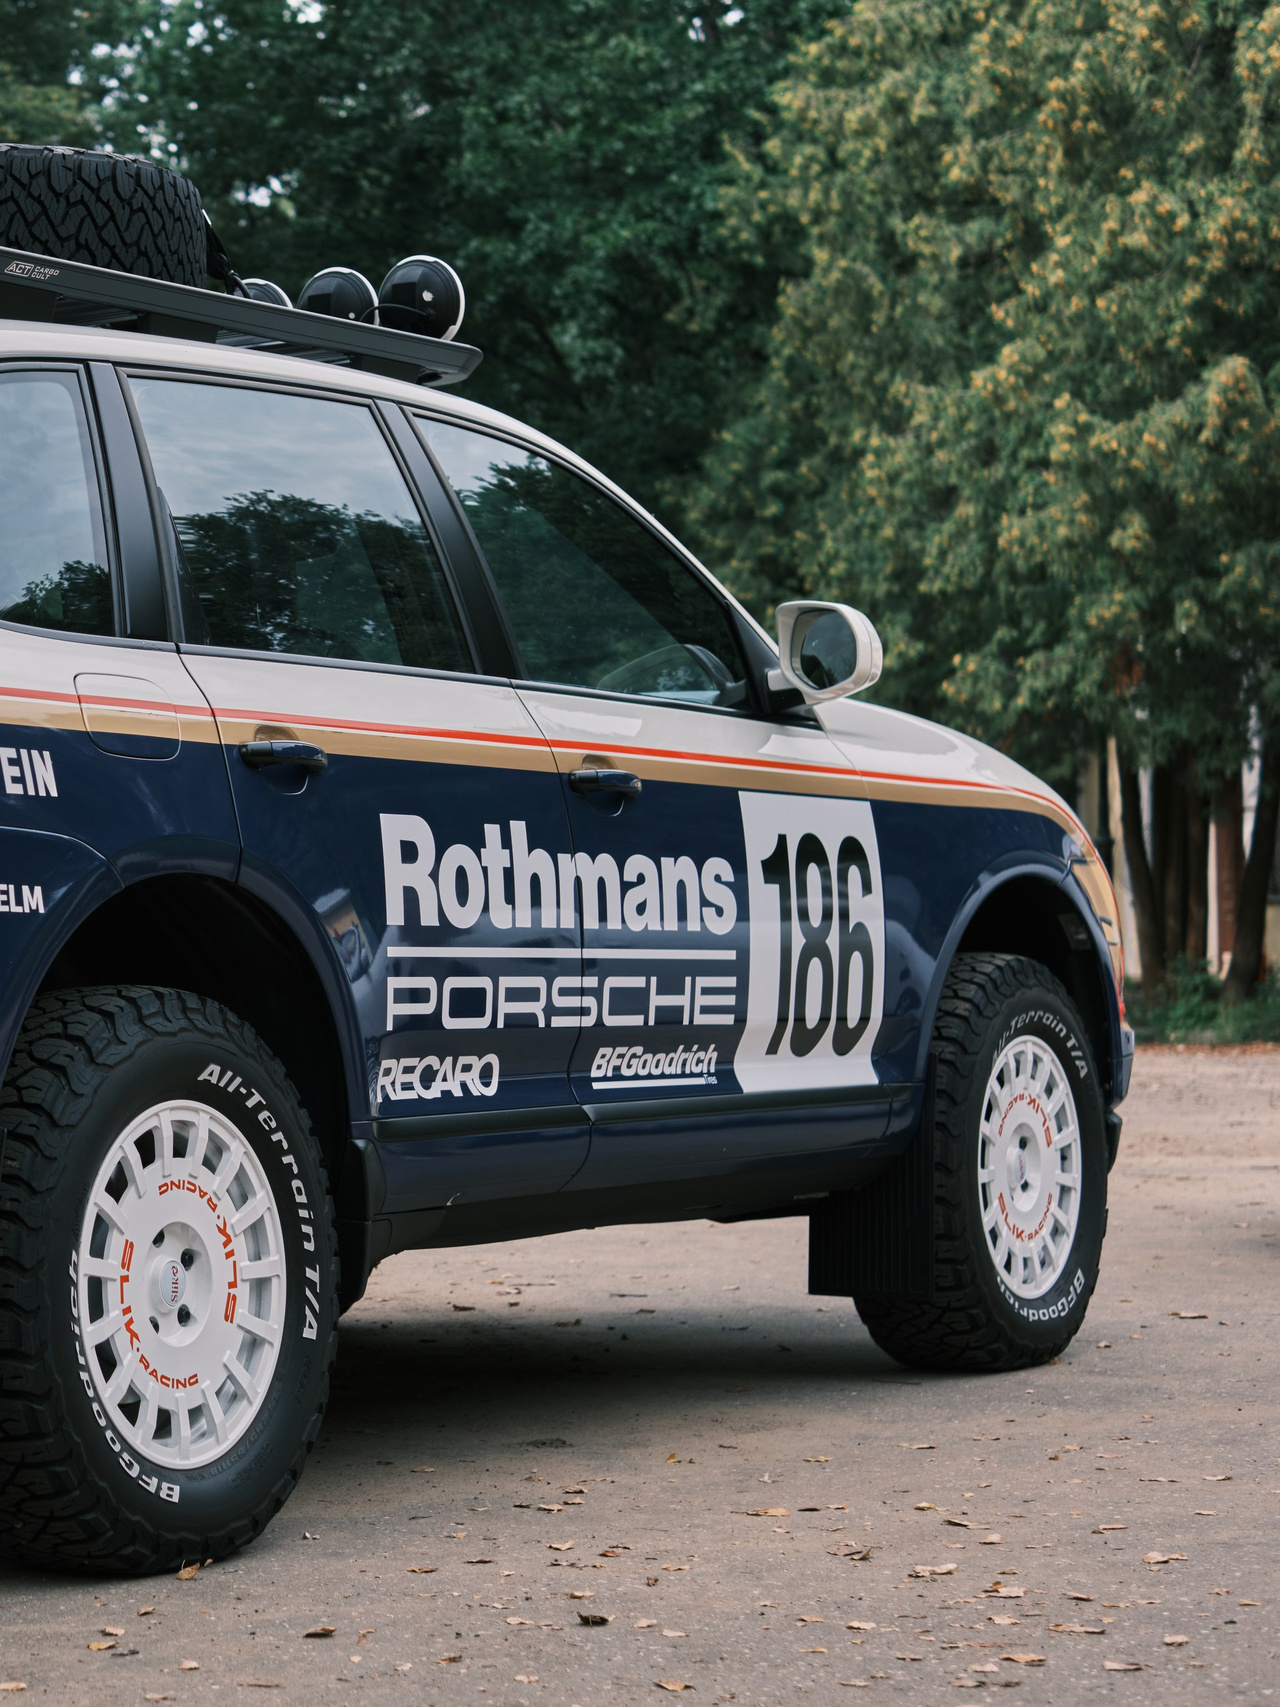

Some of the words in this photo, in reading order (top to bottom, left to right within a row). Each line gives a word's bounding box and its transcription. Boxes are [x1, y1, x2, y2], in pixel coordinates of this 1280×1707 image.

[7, 263, 32, 275] ACT
[31, 272, 51, 280] CULT
[34, 266, 60, 276] CARGO
[379, 813, 737, 936] Rothmans
[761, 832, 875, 1059] 186
[386, 976, 737, 1031] PORSCHE
[376, 1053, 500, 1103] RECARO
[590, 1043, 718, 1078] BFGoodrich
[197, 1063, 316, 1252] All-Terrain
[302, 1264, 320, 1340] T/A
[69, 1249, 181, 1504] BFGoodrich
